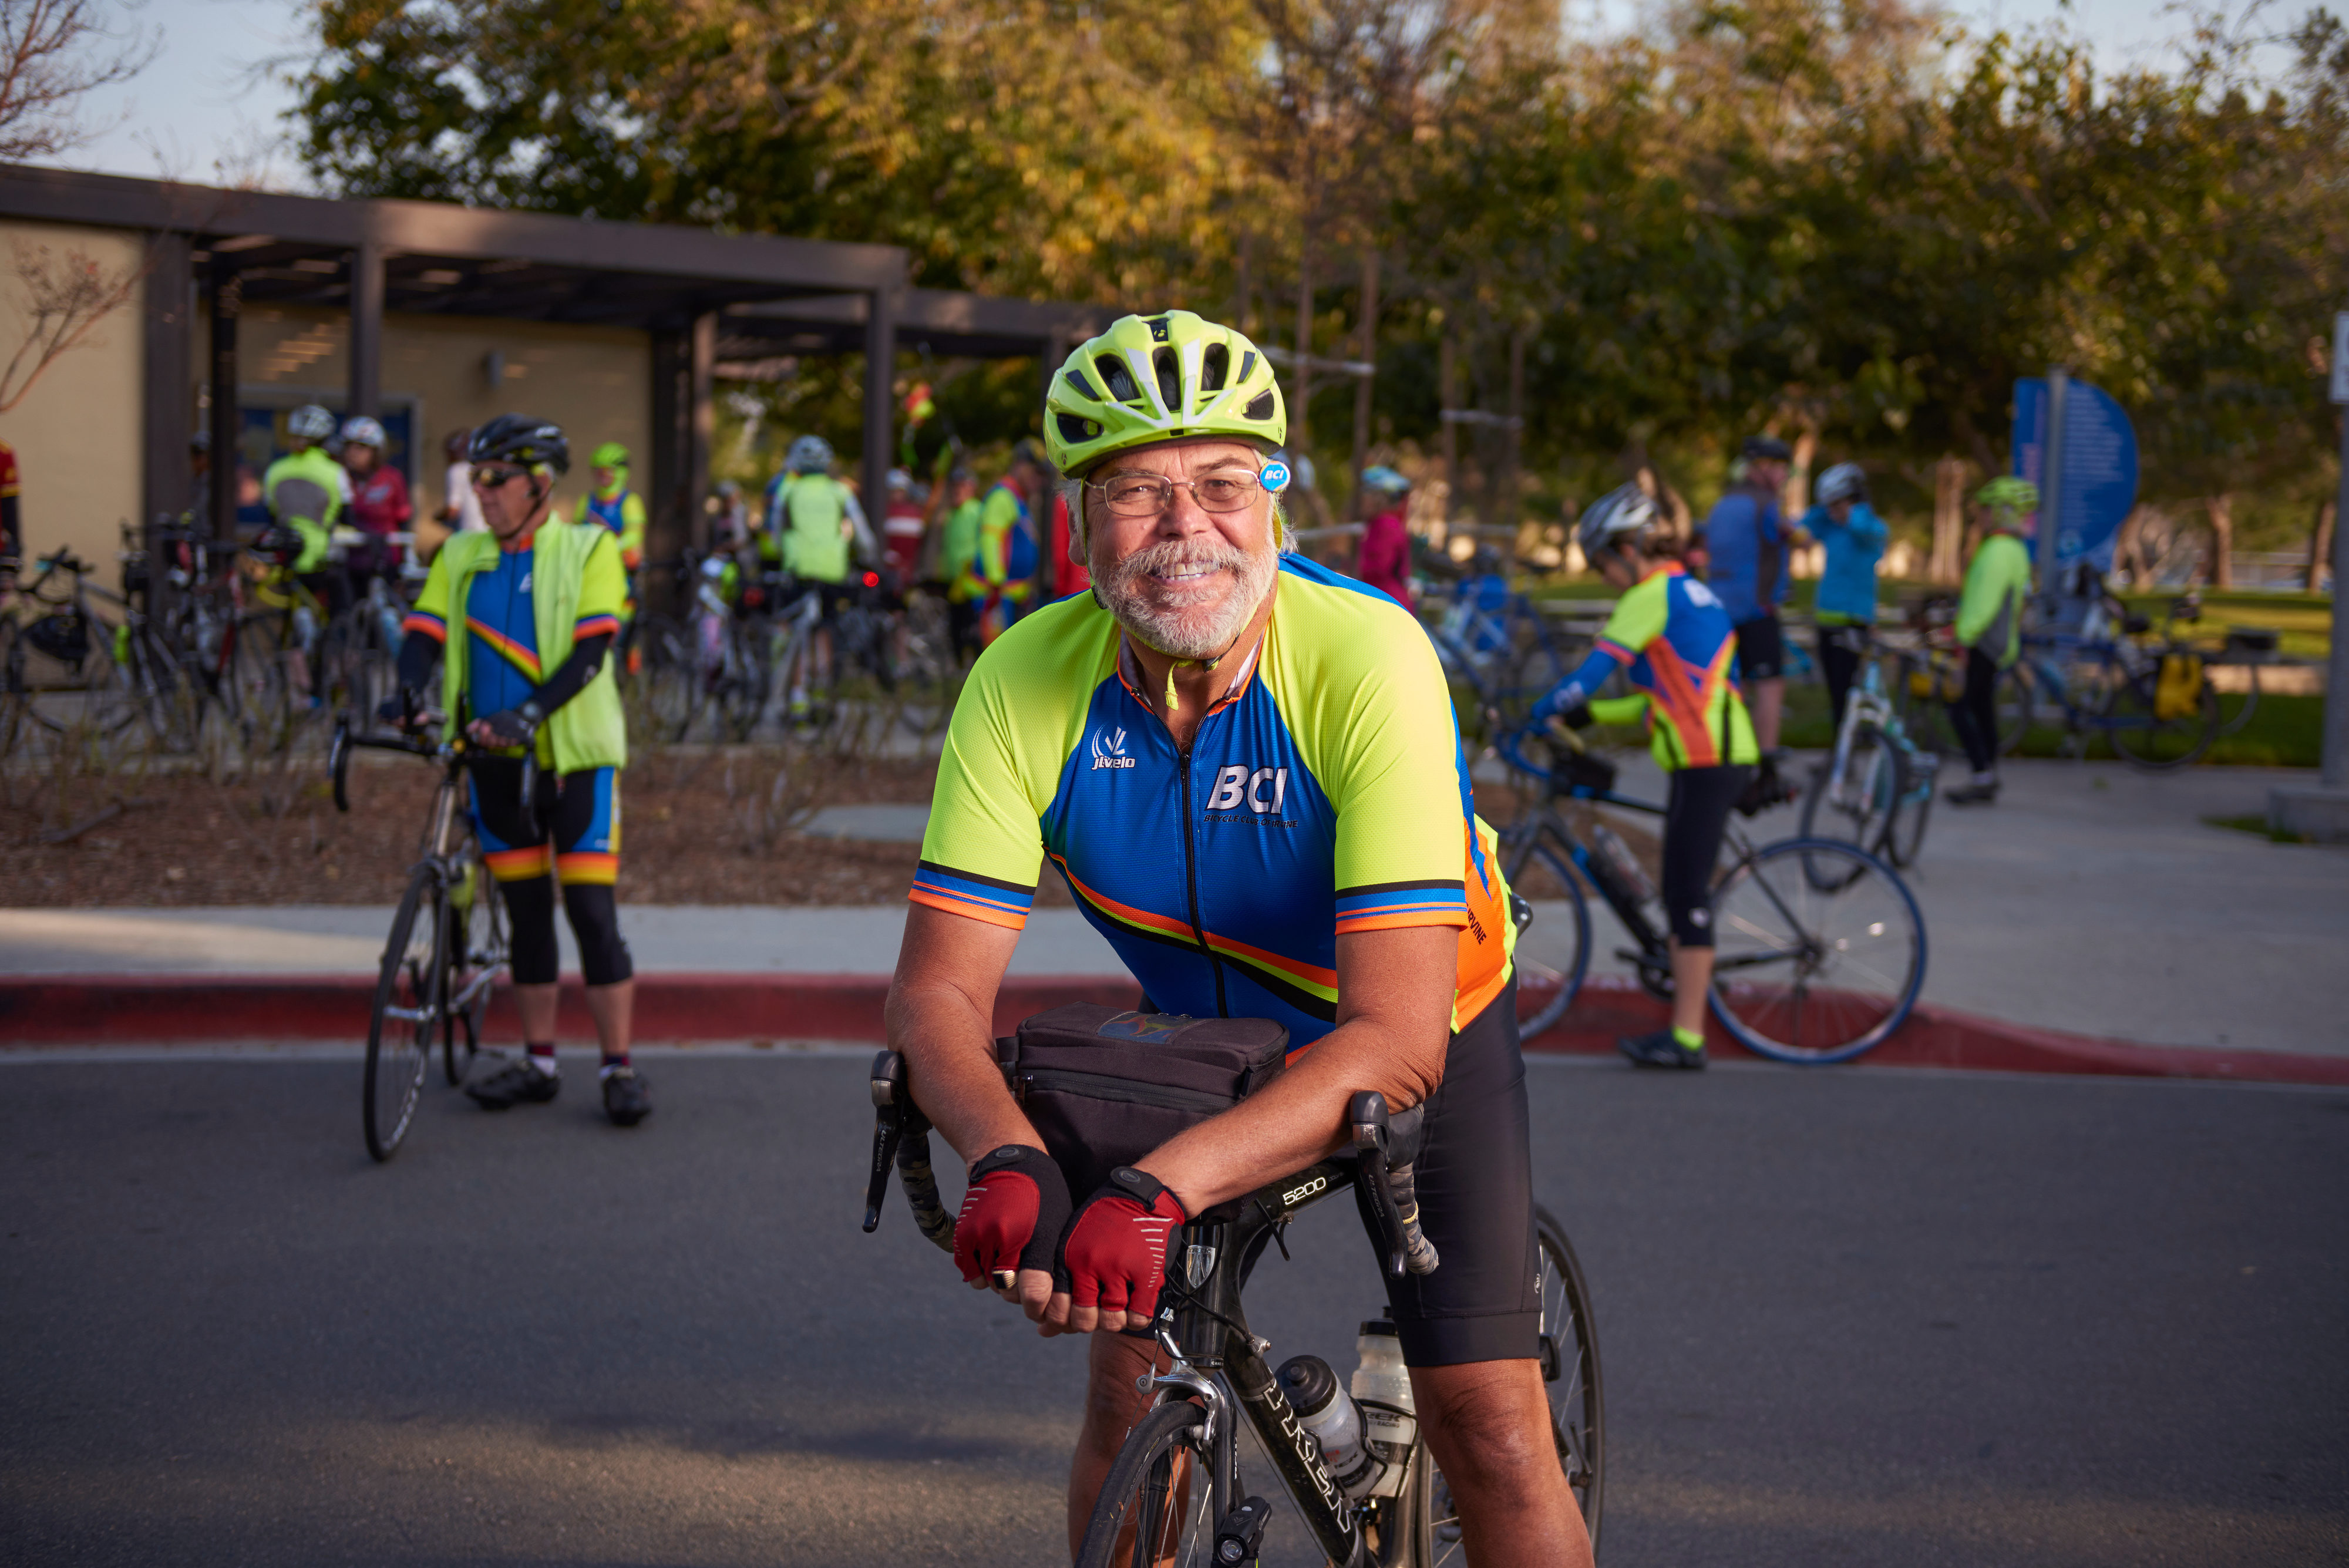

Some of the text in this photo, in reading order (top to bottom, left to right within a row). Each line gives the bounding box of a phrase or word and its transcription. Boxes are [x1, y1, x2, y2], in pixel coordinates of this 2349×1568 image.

[1264, 469, 1284, 480] BCI
[1204, 765, 1288, 816] BCI
[1203, 814, 1240, 823] BICYCLE
[1240, 815, 1259, 826] CLUB
[1271, 819, 1298, 829] IRVINE
[1467, 909, 1487, 945] IRVINE
[876, 1129, 887, 1172] ULTEGRA
[1282, 1176, 1327, 1206] 5200
